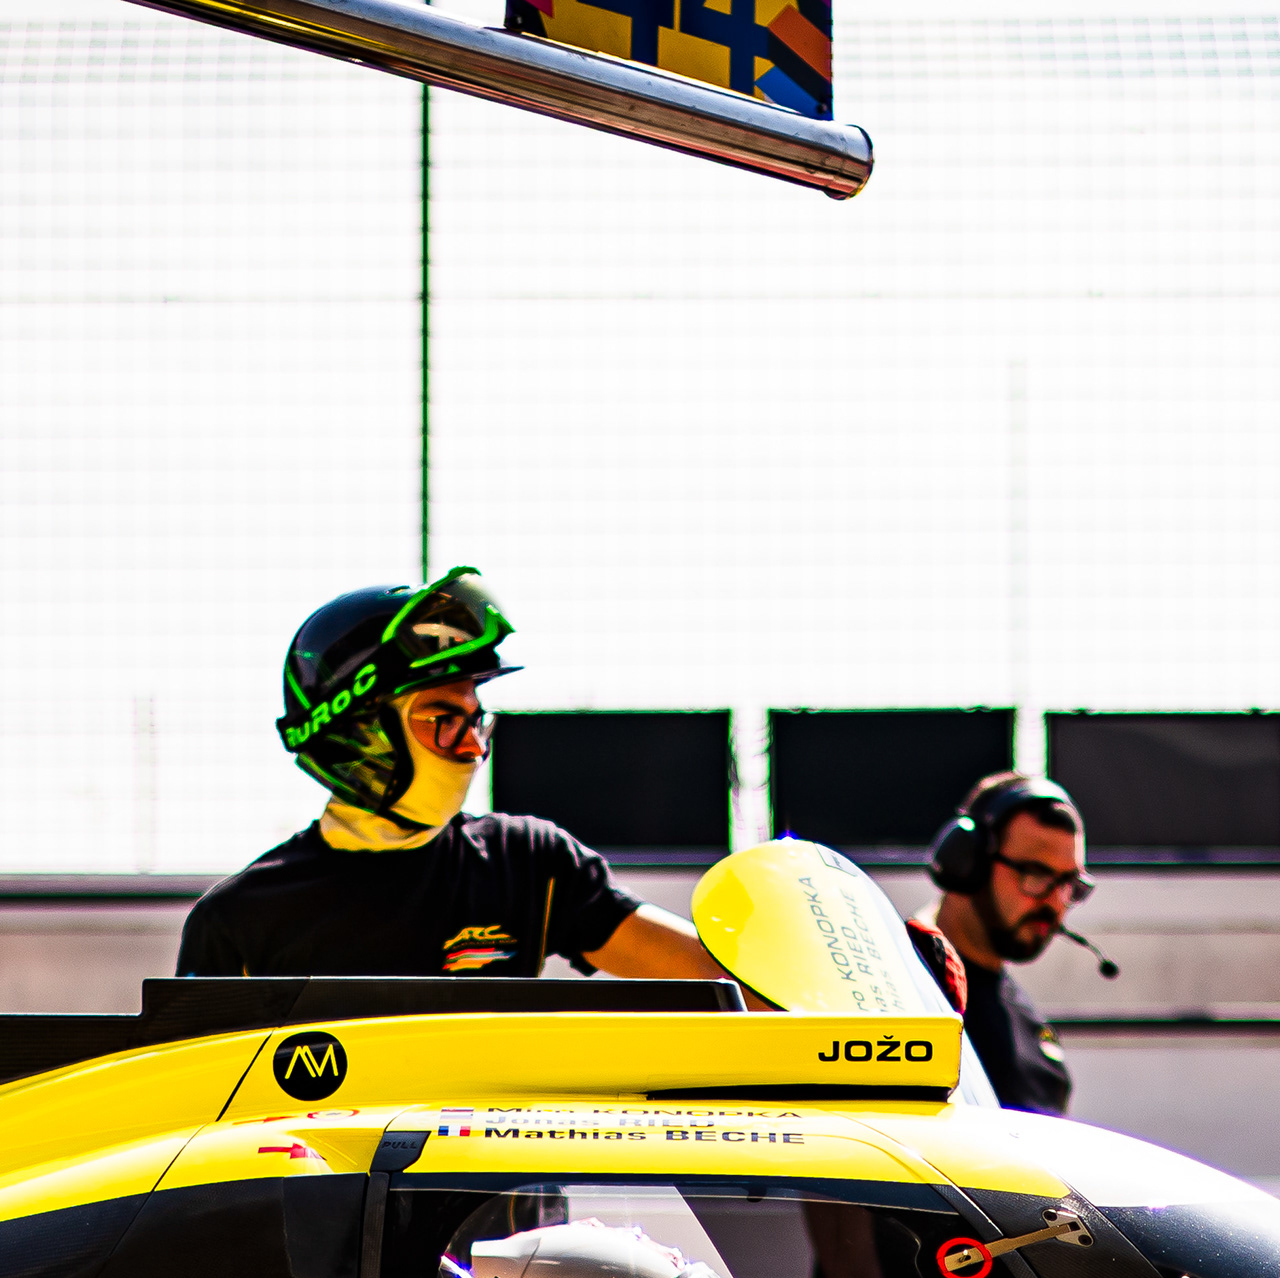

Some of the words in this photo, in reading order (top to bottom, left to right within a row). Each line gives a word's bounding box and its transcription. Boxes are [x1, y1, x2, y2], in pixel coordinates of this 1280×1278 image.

[799, 876, 857, 982] KONOPKA
[818, 1035, 933, 1062] JOŽO
[484, 1127, 647, 1141] Mathias
[665, 1129, 806, 1145] BECHE
